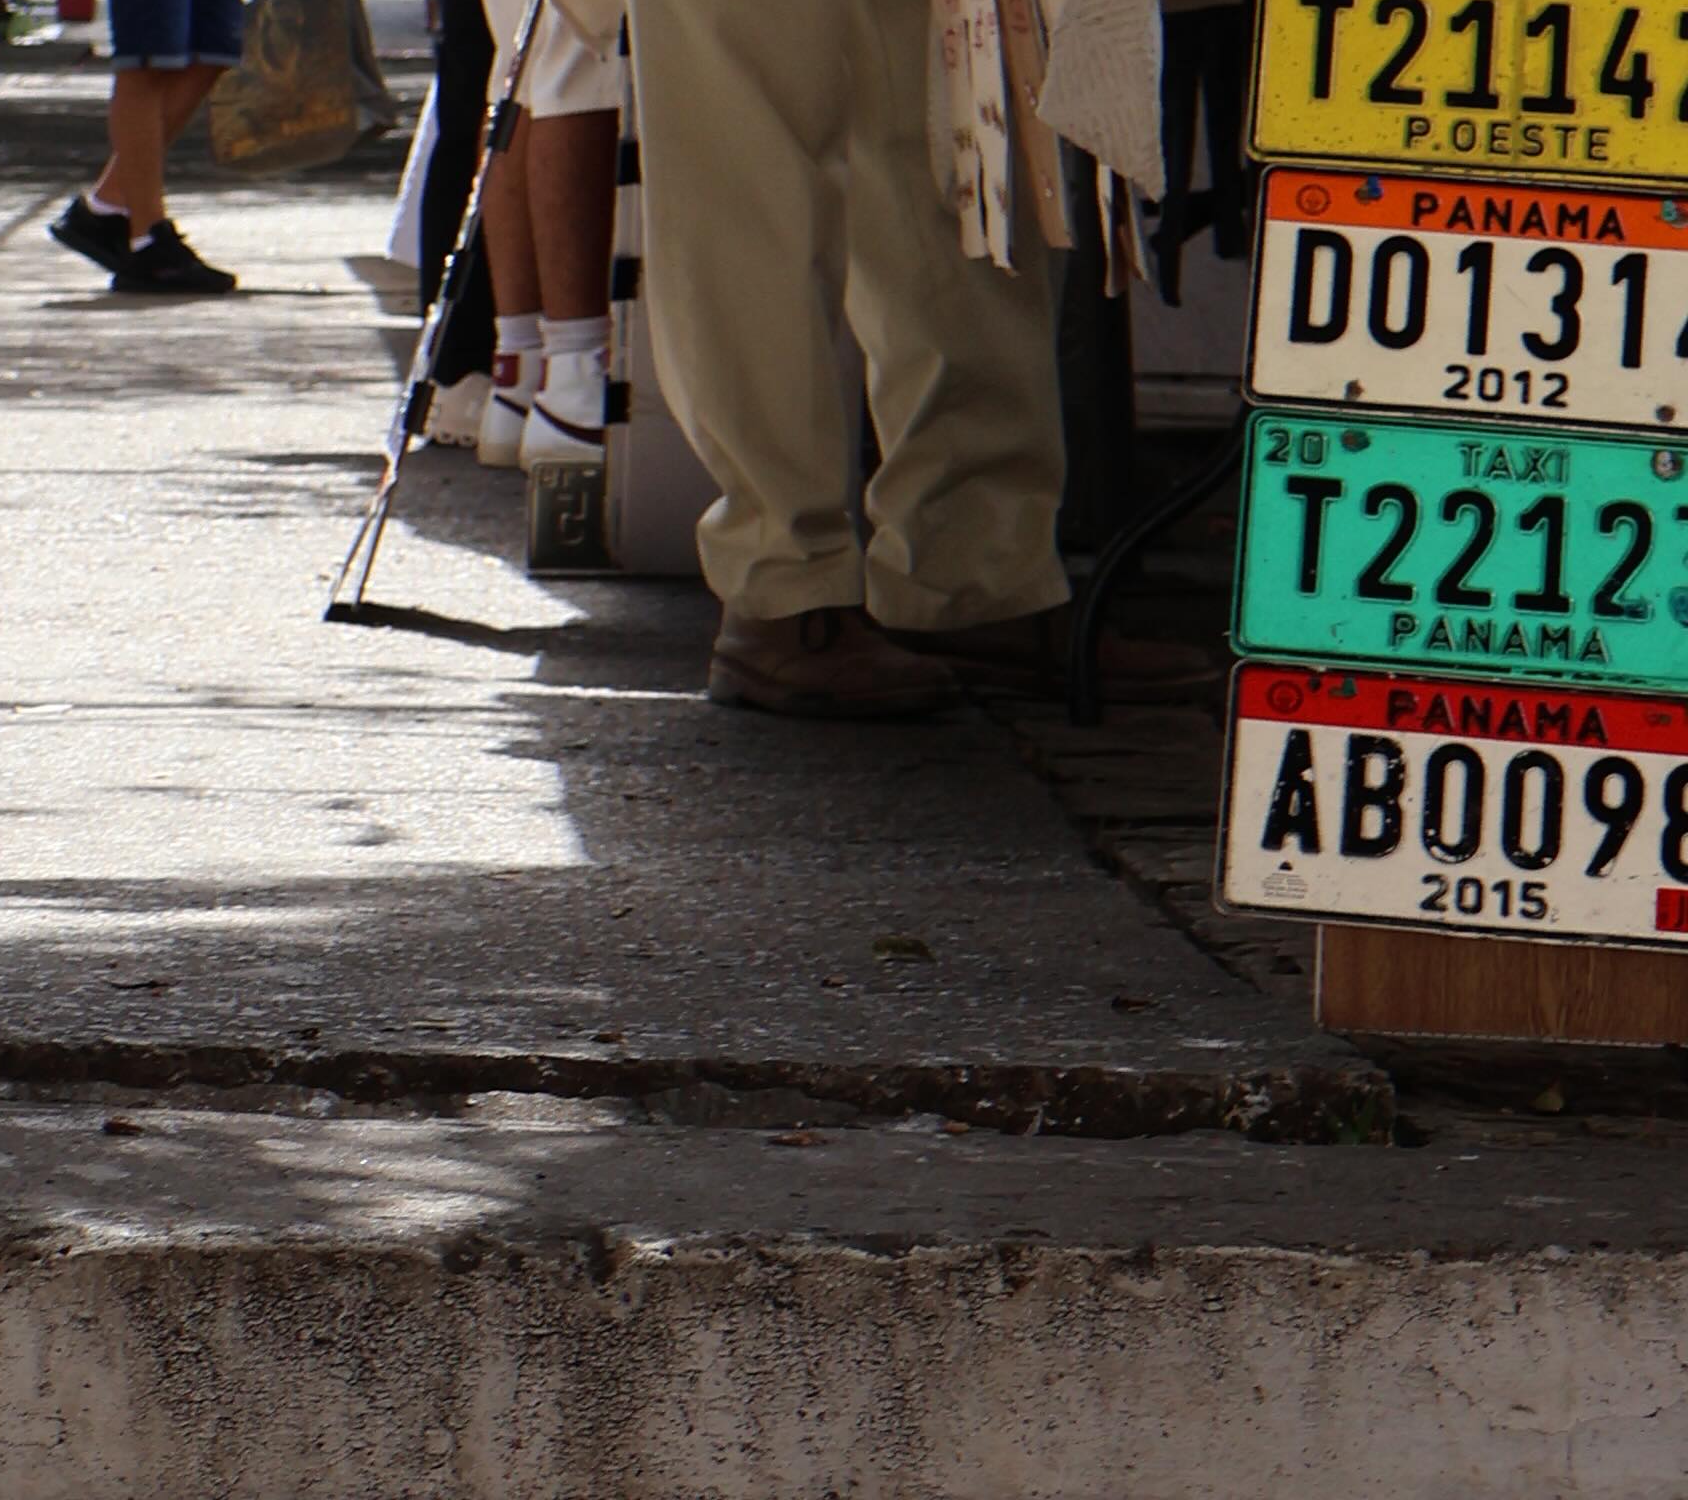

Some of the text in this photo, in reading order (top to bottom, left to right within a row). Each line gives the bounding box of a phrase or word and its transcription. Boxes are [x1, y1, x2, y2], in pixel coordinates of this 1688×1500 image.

[1411, 191, 1626, 242] PANAMA
[1442, 363, 1570, 409] 2012
[1459, 441, 1572, 485] TAXI
[1285, 474, 1688, 621] T2212
[1387, 611, 1613, 665] PANAMA
[1385, 688, 1610, 746] PANAMA
[1420, 872, 1550, 921] 2015
